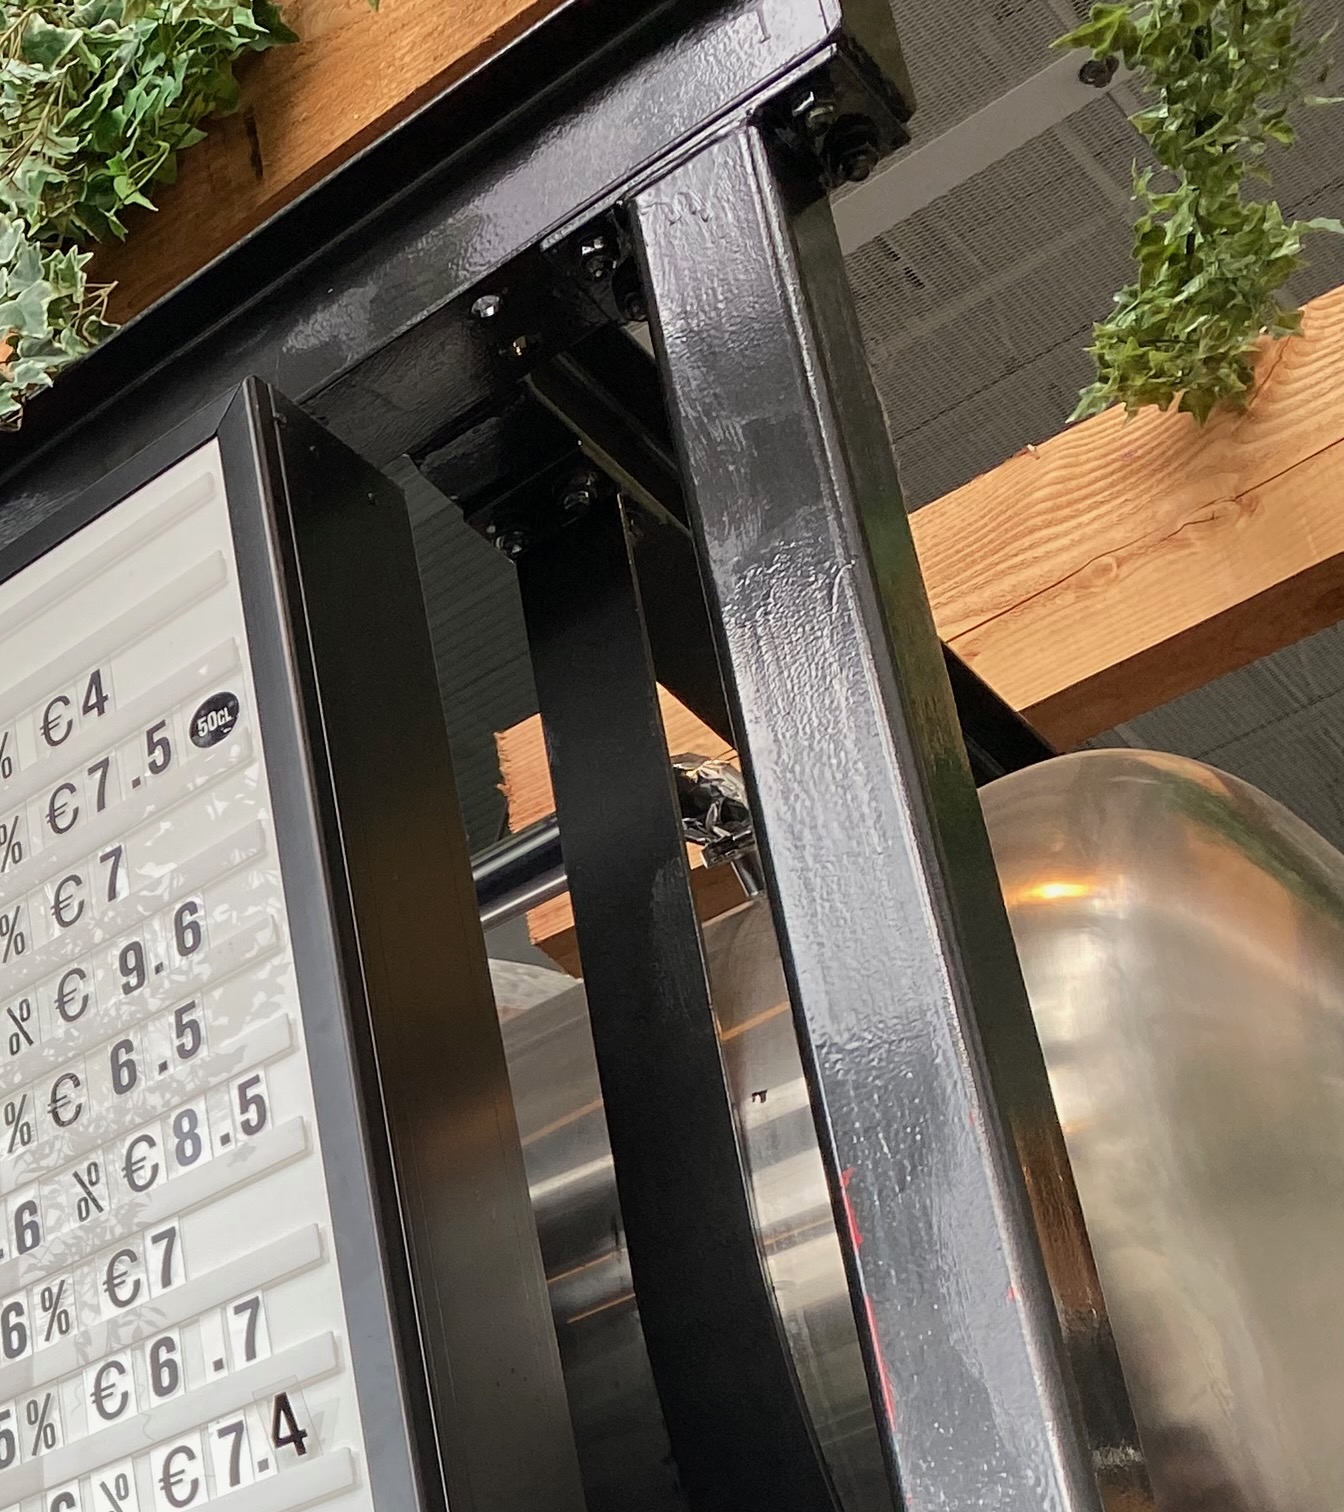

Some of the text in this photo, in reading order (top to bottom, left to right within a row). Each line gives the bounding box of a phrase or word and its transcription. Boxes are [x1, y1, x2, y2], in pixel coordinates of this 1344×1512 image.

[40, 668, 110, 747] €4
[46, 719, 172, 836] €7.5
[50, 845, 124, 929] €7
[121, 1074, 267, 1193] €8.5
[102, 1225, 178, 1308] €7
[90, 1296, 261, 1421] €6.7
[158, 1391, 308, 1509] €7.4
